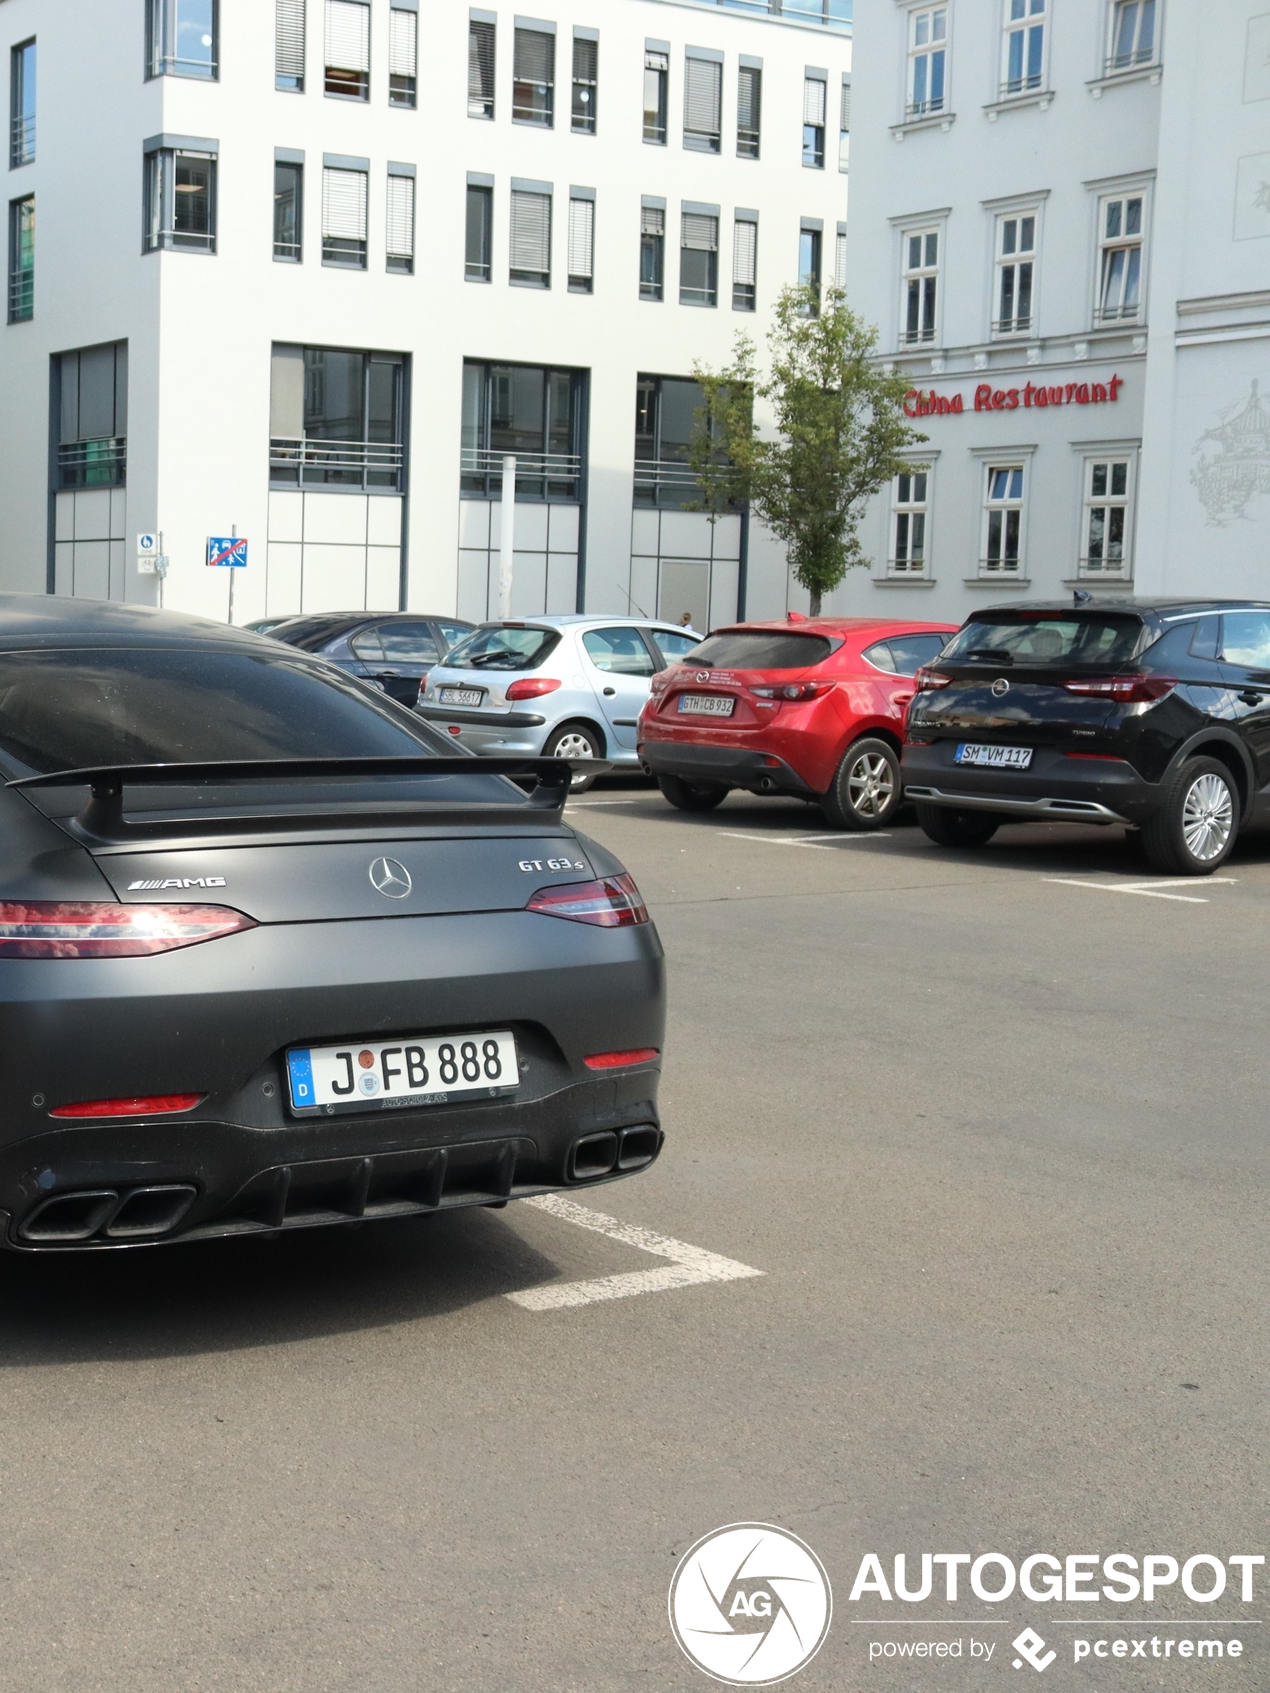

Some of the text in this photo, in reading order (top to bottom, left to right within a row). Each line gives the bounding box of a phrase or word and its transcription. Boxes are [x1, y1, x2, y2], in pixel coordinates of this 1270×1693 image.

[903, 373, 1123, 417] China Restaurant
[683, 697, 733, 712] GTH CB 932
[963, 745, 1031, 763] SM VM 117
[518, 860, 543, 872] GT
[160, 877, 227, 888] AMG
[331, 1039, 502, 1095] J FB 888
[299, 1083, 309, 1097] D
